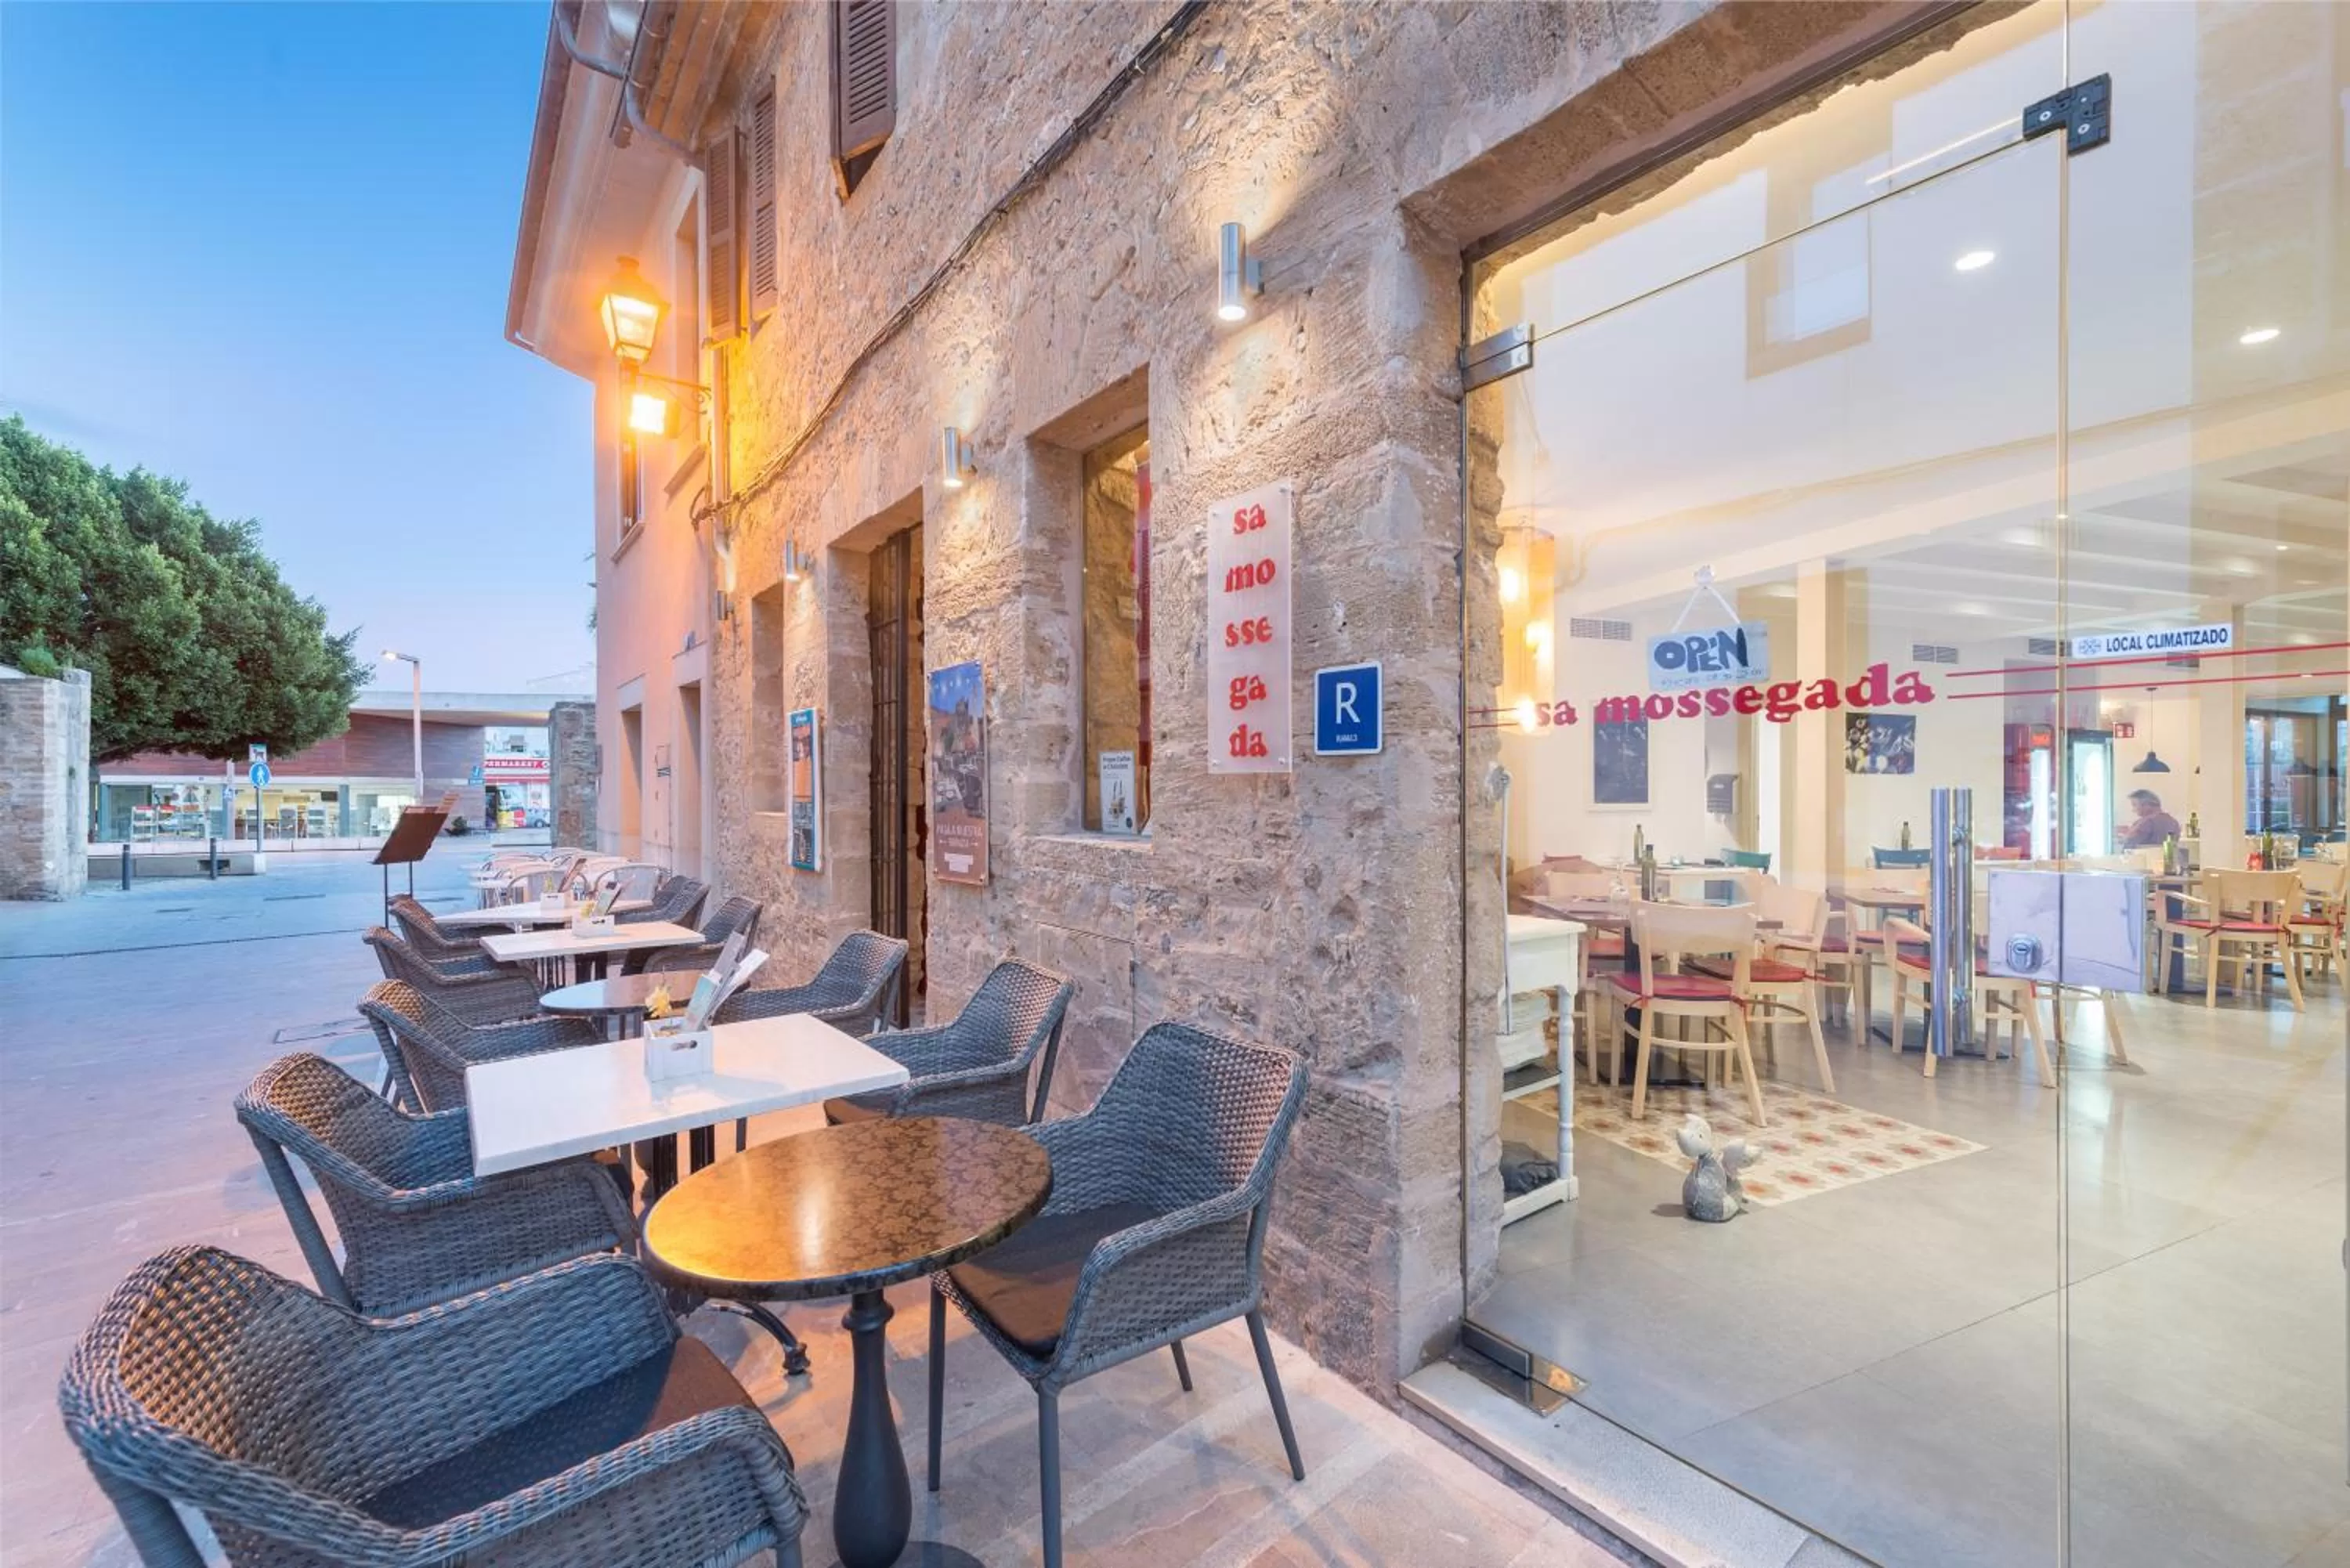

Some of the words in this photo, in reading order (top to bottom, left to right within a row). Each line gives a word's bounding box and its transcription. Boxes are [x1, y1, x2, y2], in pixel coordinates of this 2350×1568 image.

[1234, 504, 1267, 534] sa
[1224, 558, 1276, 593] mo
[1225, 616, 1273, 648] sse
[1654, 627, 1748, 672] OPEN
[2106, 636, 2142, 652] LOCAL
[2146, 628, 2229, 649] CLIMATIZADO
[1229, 674, 1267, 711] ga
[1336, 682, 1361, 724] R
[1535, 700, 1578, 727] sa
[1594, 663, 1935, 724] mossegada
[1229, 724, 1268, 758] da
